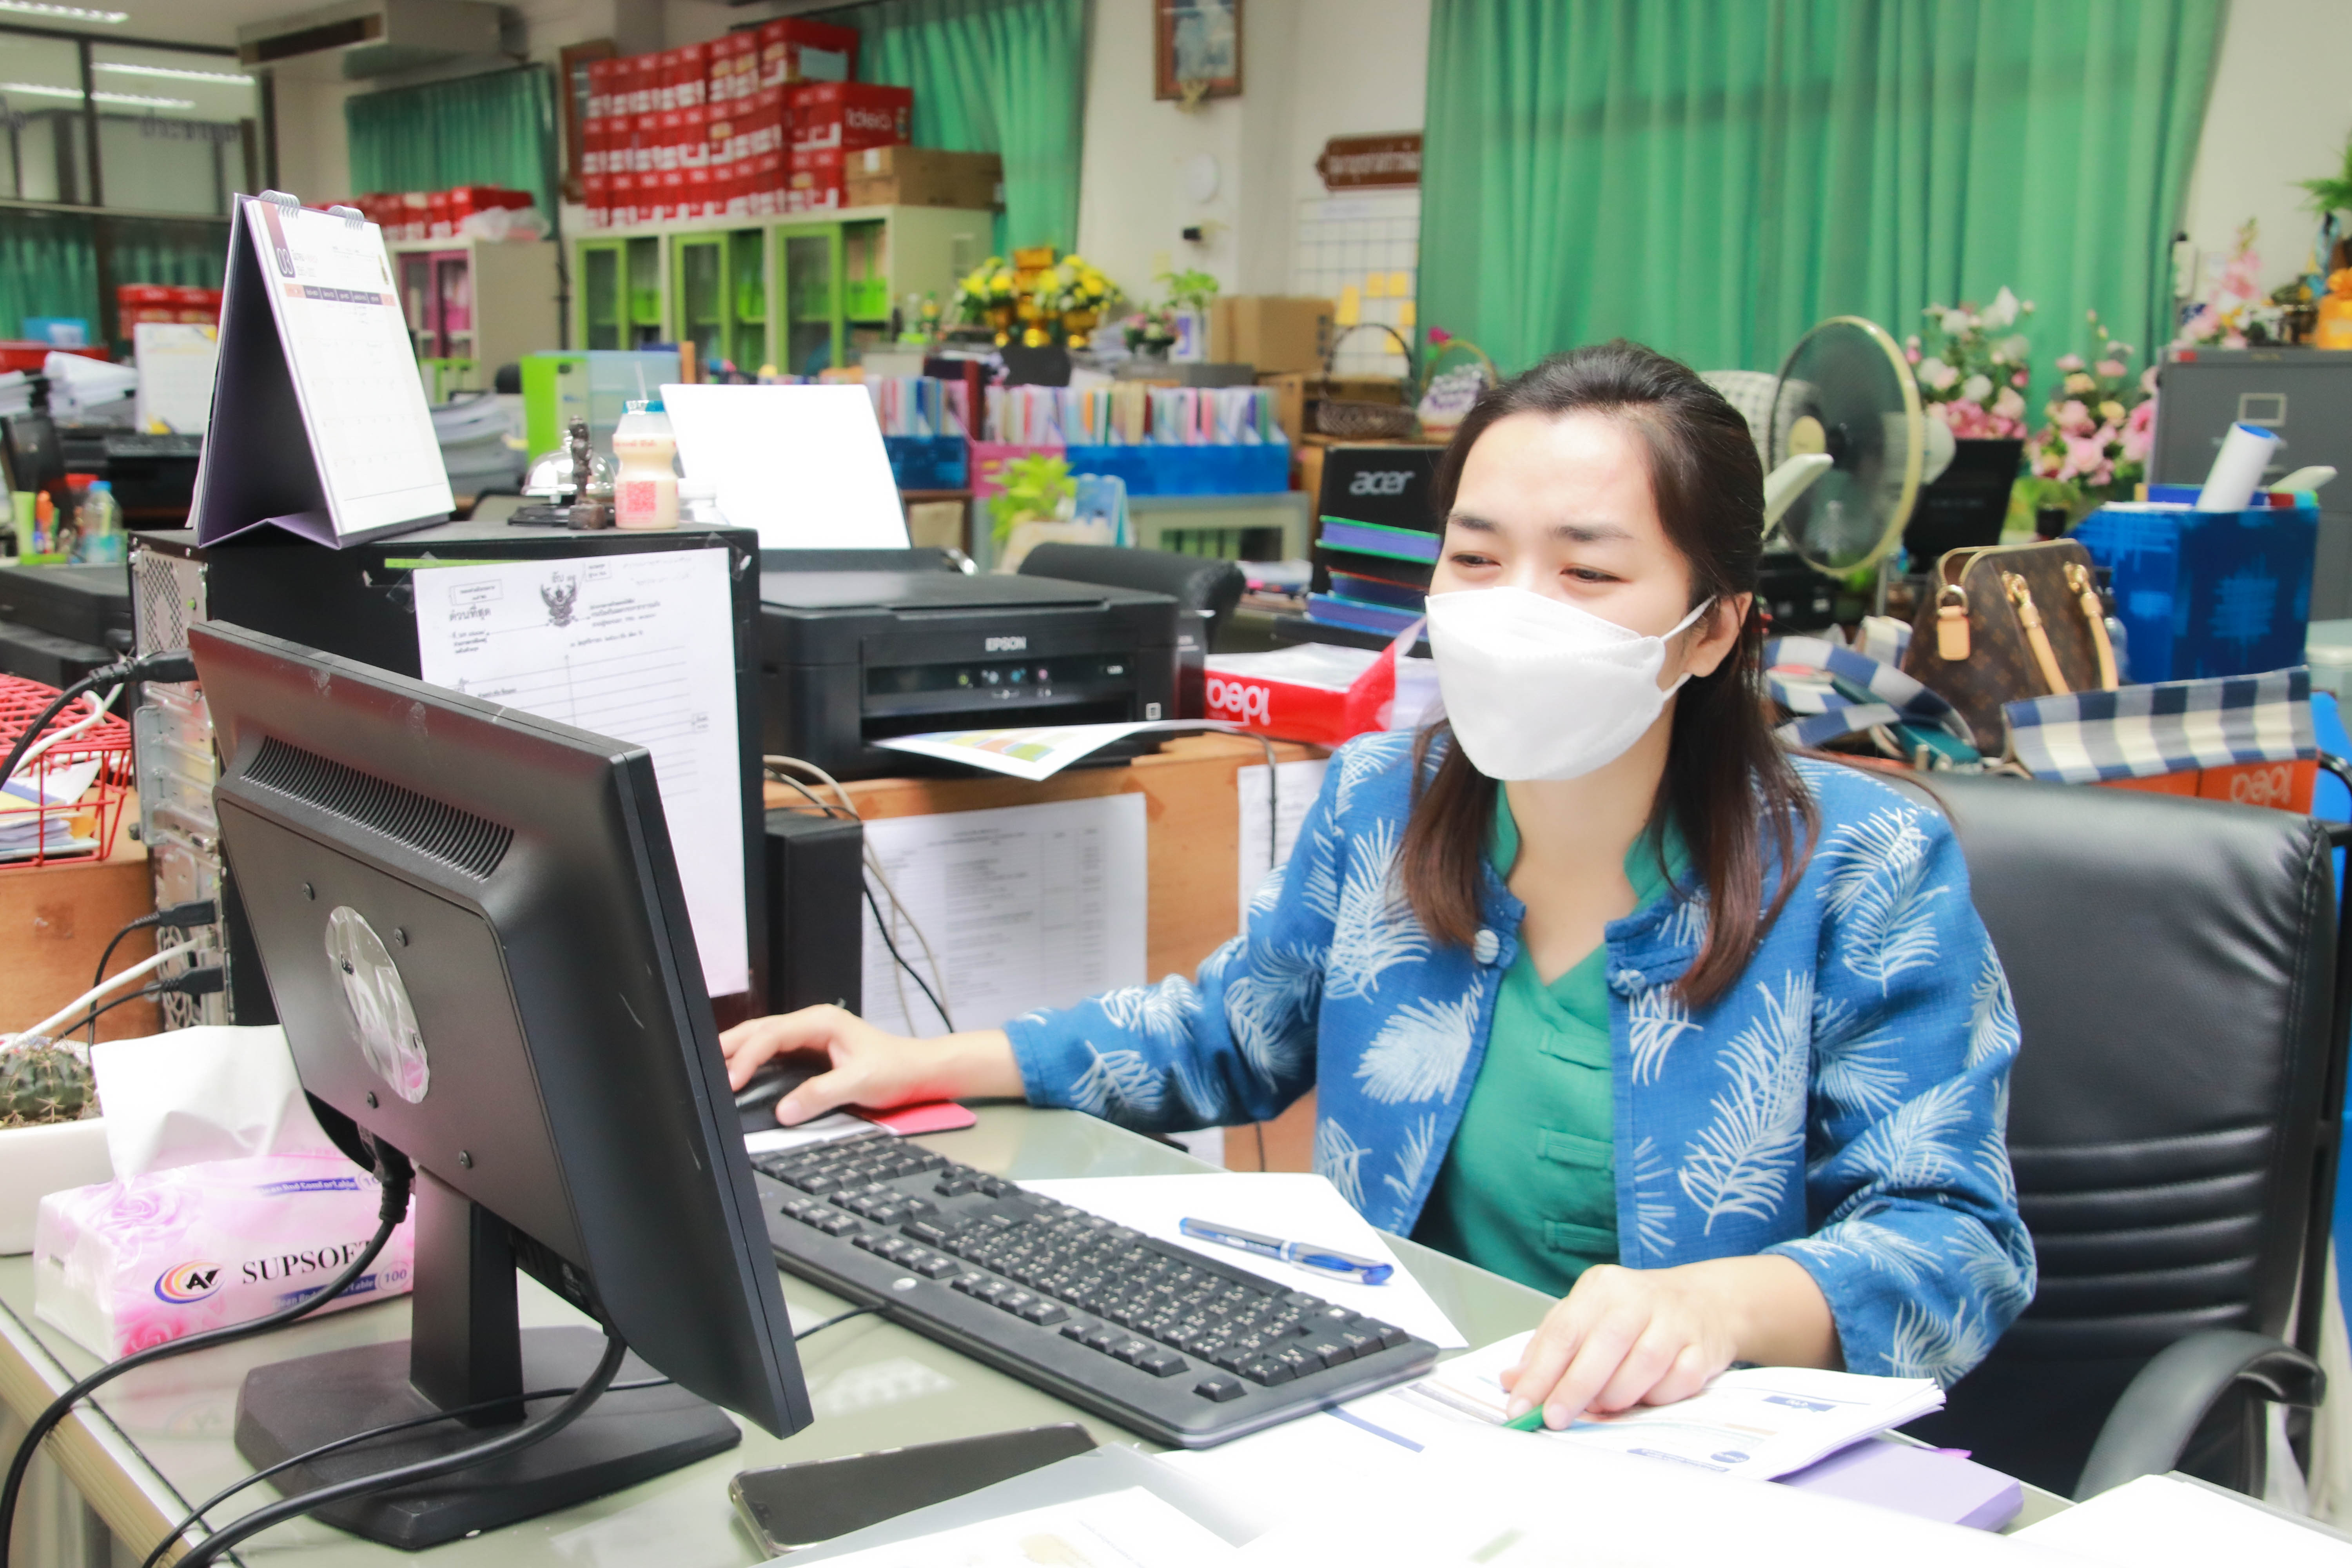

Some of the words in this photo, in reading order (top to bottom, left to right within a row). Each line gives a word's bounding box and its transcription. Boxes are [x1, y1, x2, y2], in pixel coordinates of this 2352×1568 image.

[1349, 471, 1416, 495] acer
[985, 636, 1027, 652] EPSON
[386, 1269, 407, 1283] 100
